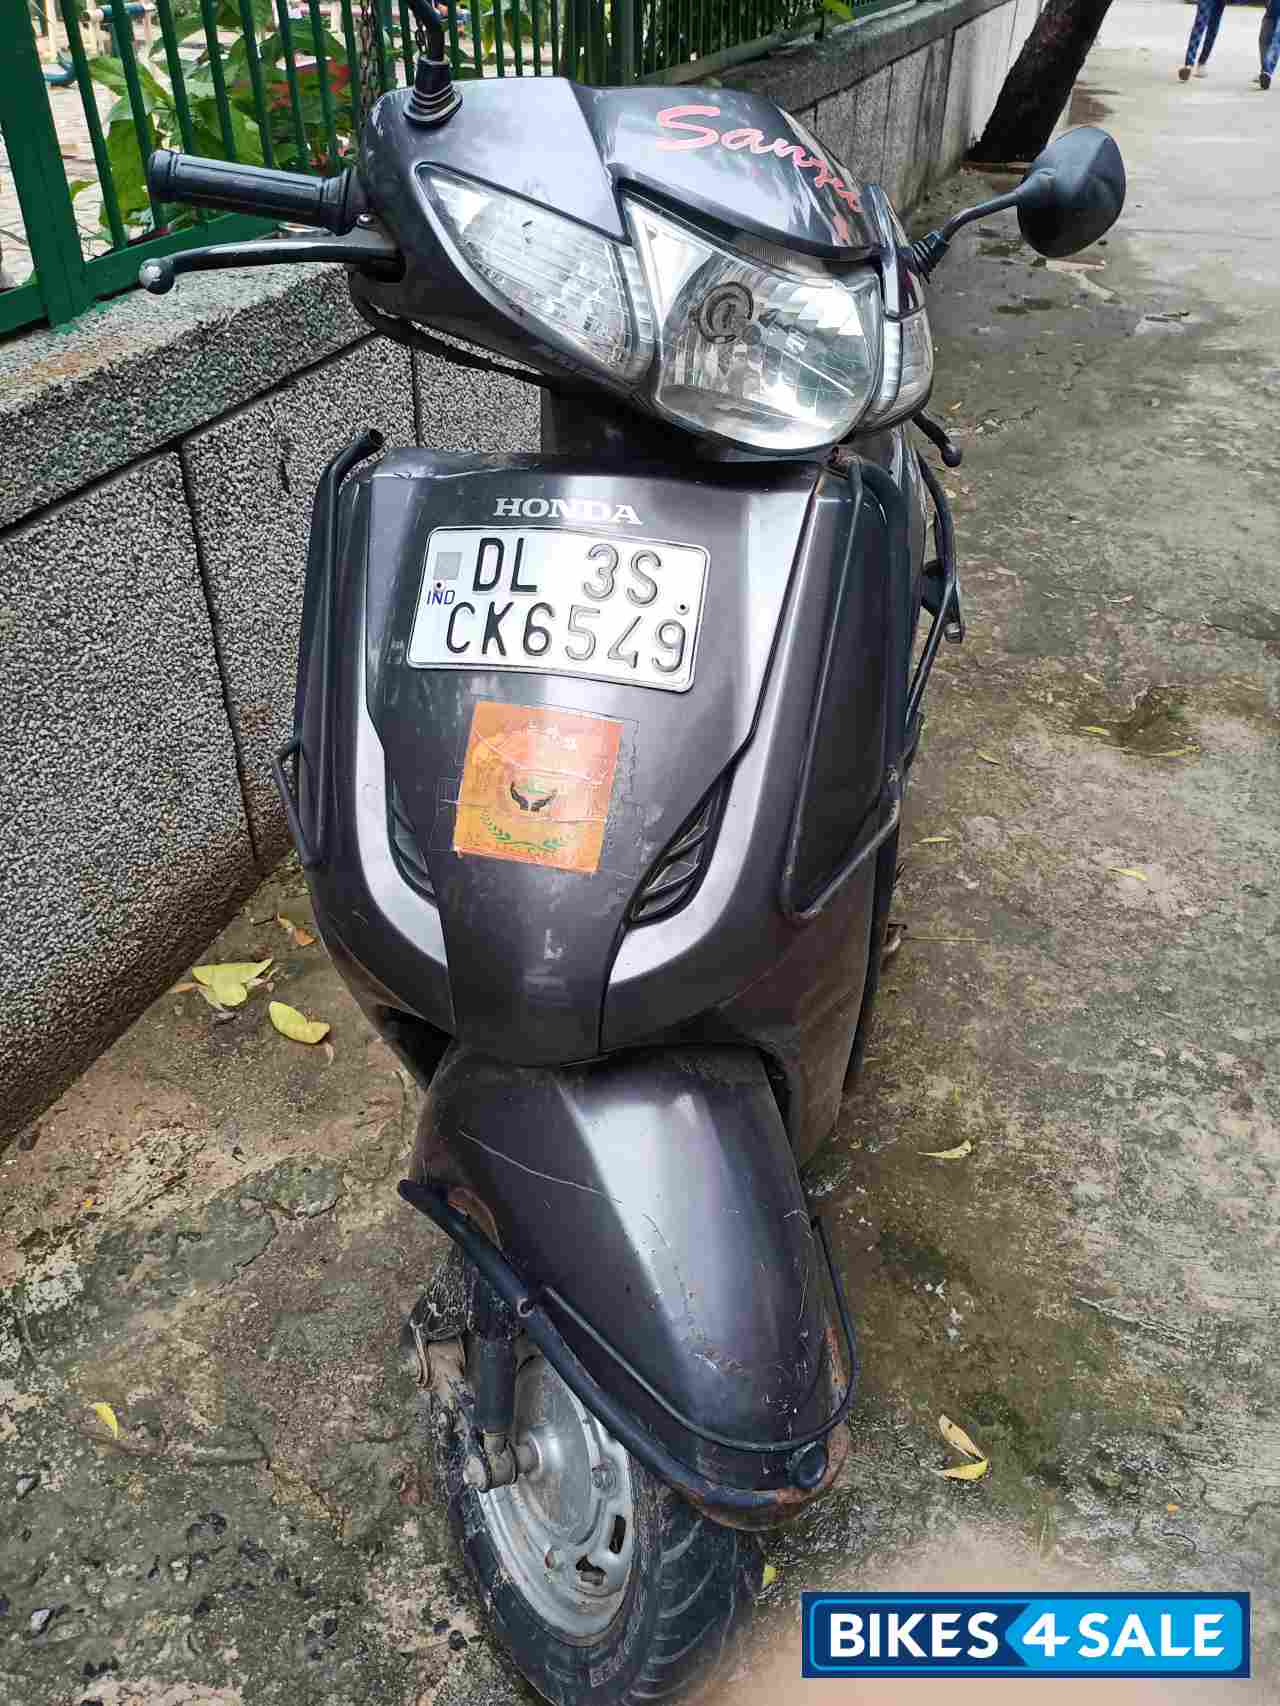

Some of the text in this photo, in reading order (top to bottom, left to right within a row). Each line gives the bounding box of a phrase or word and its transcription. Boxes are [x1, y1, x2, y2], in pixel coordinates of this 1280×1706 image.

[492, 497, 643, 525] HONDA
[472, 537, 662, 606] DL 3S
[426, 589, 456, 606] IND
[445, 601, 687, 673] CK6549
